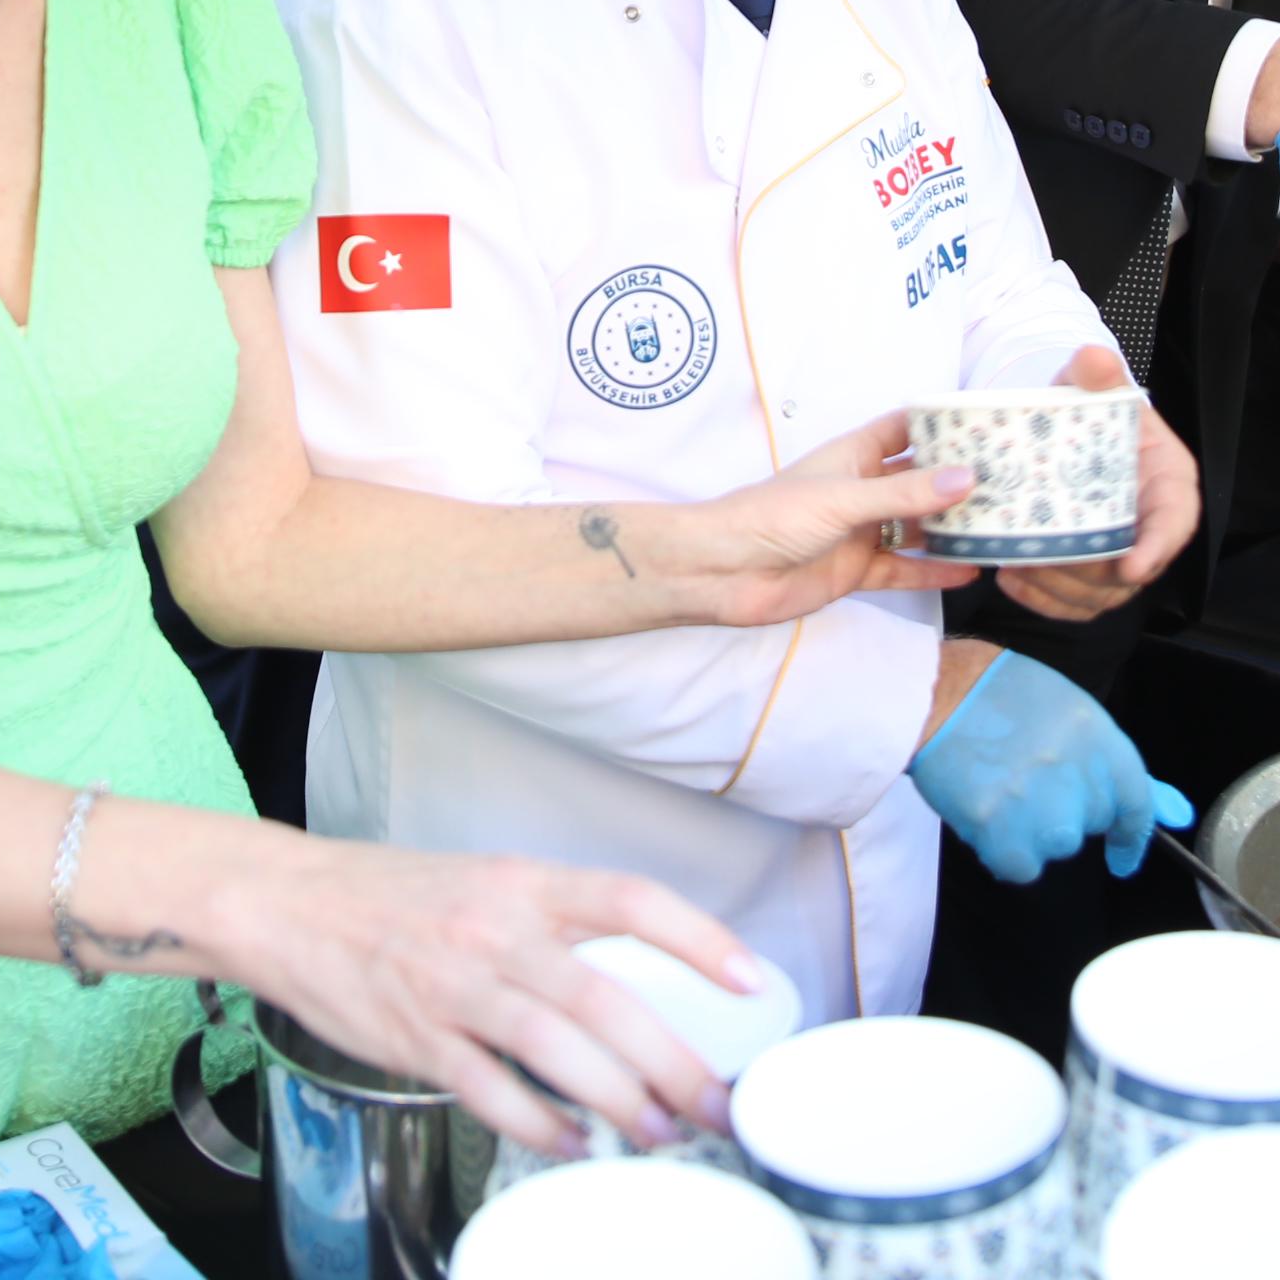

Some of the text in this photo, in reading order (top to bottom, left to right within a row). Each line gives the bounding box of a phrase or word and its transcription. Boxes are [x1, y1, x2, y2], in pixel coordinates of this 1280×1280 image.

[603, 271, 663, 299] BURSA
[576, 317, 711, 405] BÜYÜKŞEHİR BELEDİYESİ
[26, 1137, 130, 1241] CoreMed
